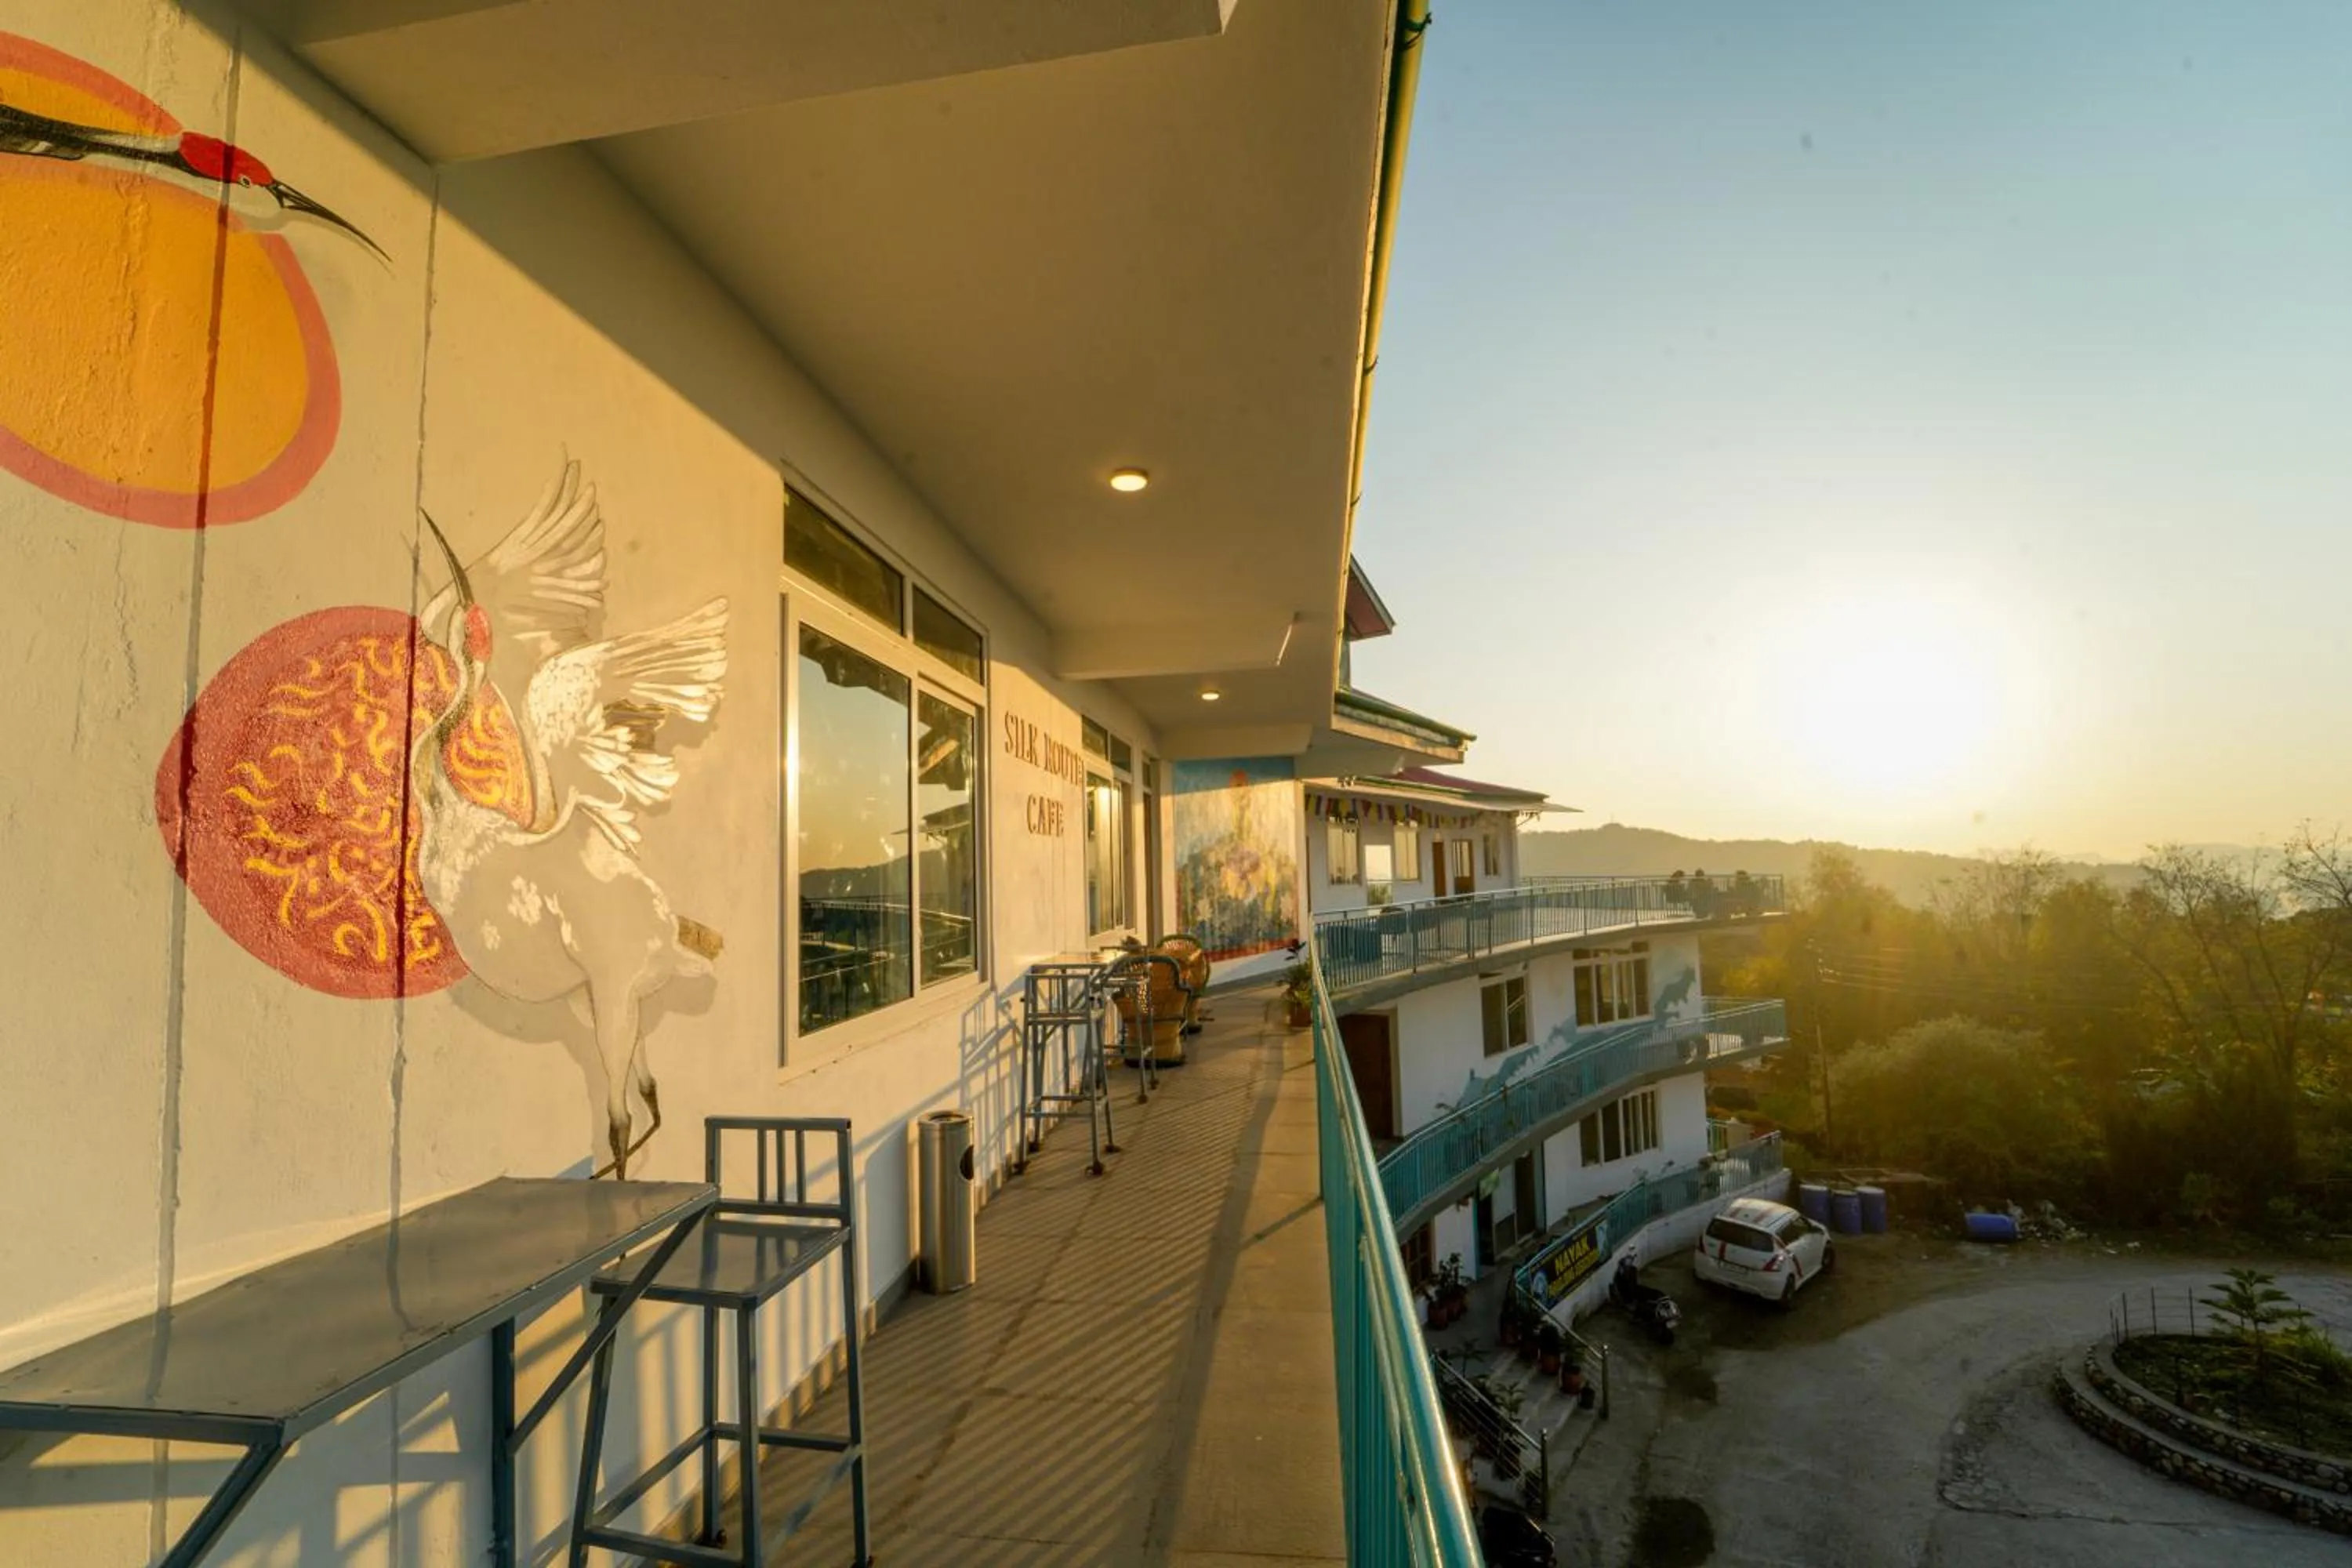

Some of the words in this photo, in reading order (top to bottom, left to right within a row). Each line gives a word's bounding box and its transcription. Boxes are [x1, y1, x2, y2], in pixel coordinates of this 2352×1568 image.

[1004, 710, 1040, 768] SILK
[1044, 731, 1084, 786] ROUTE
[1026, 793, 1064, 838] CAFE
